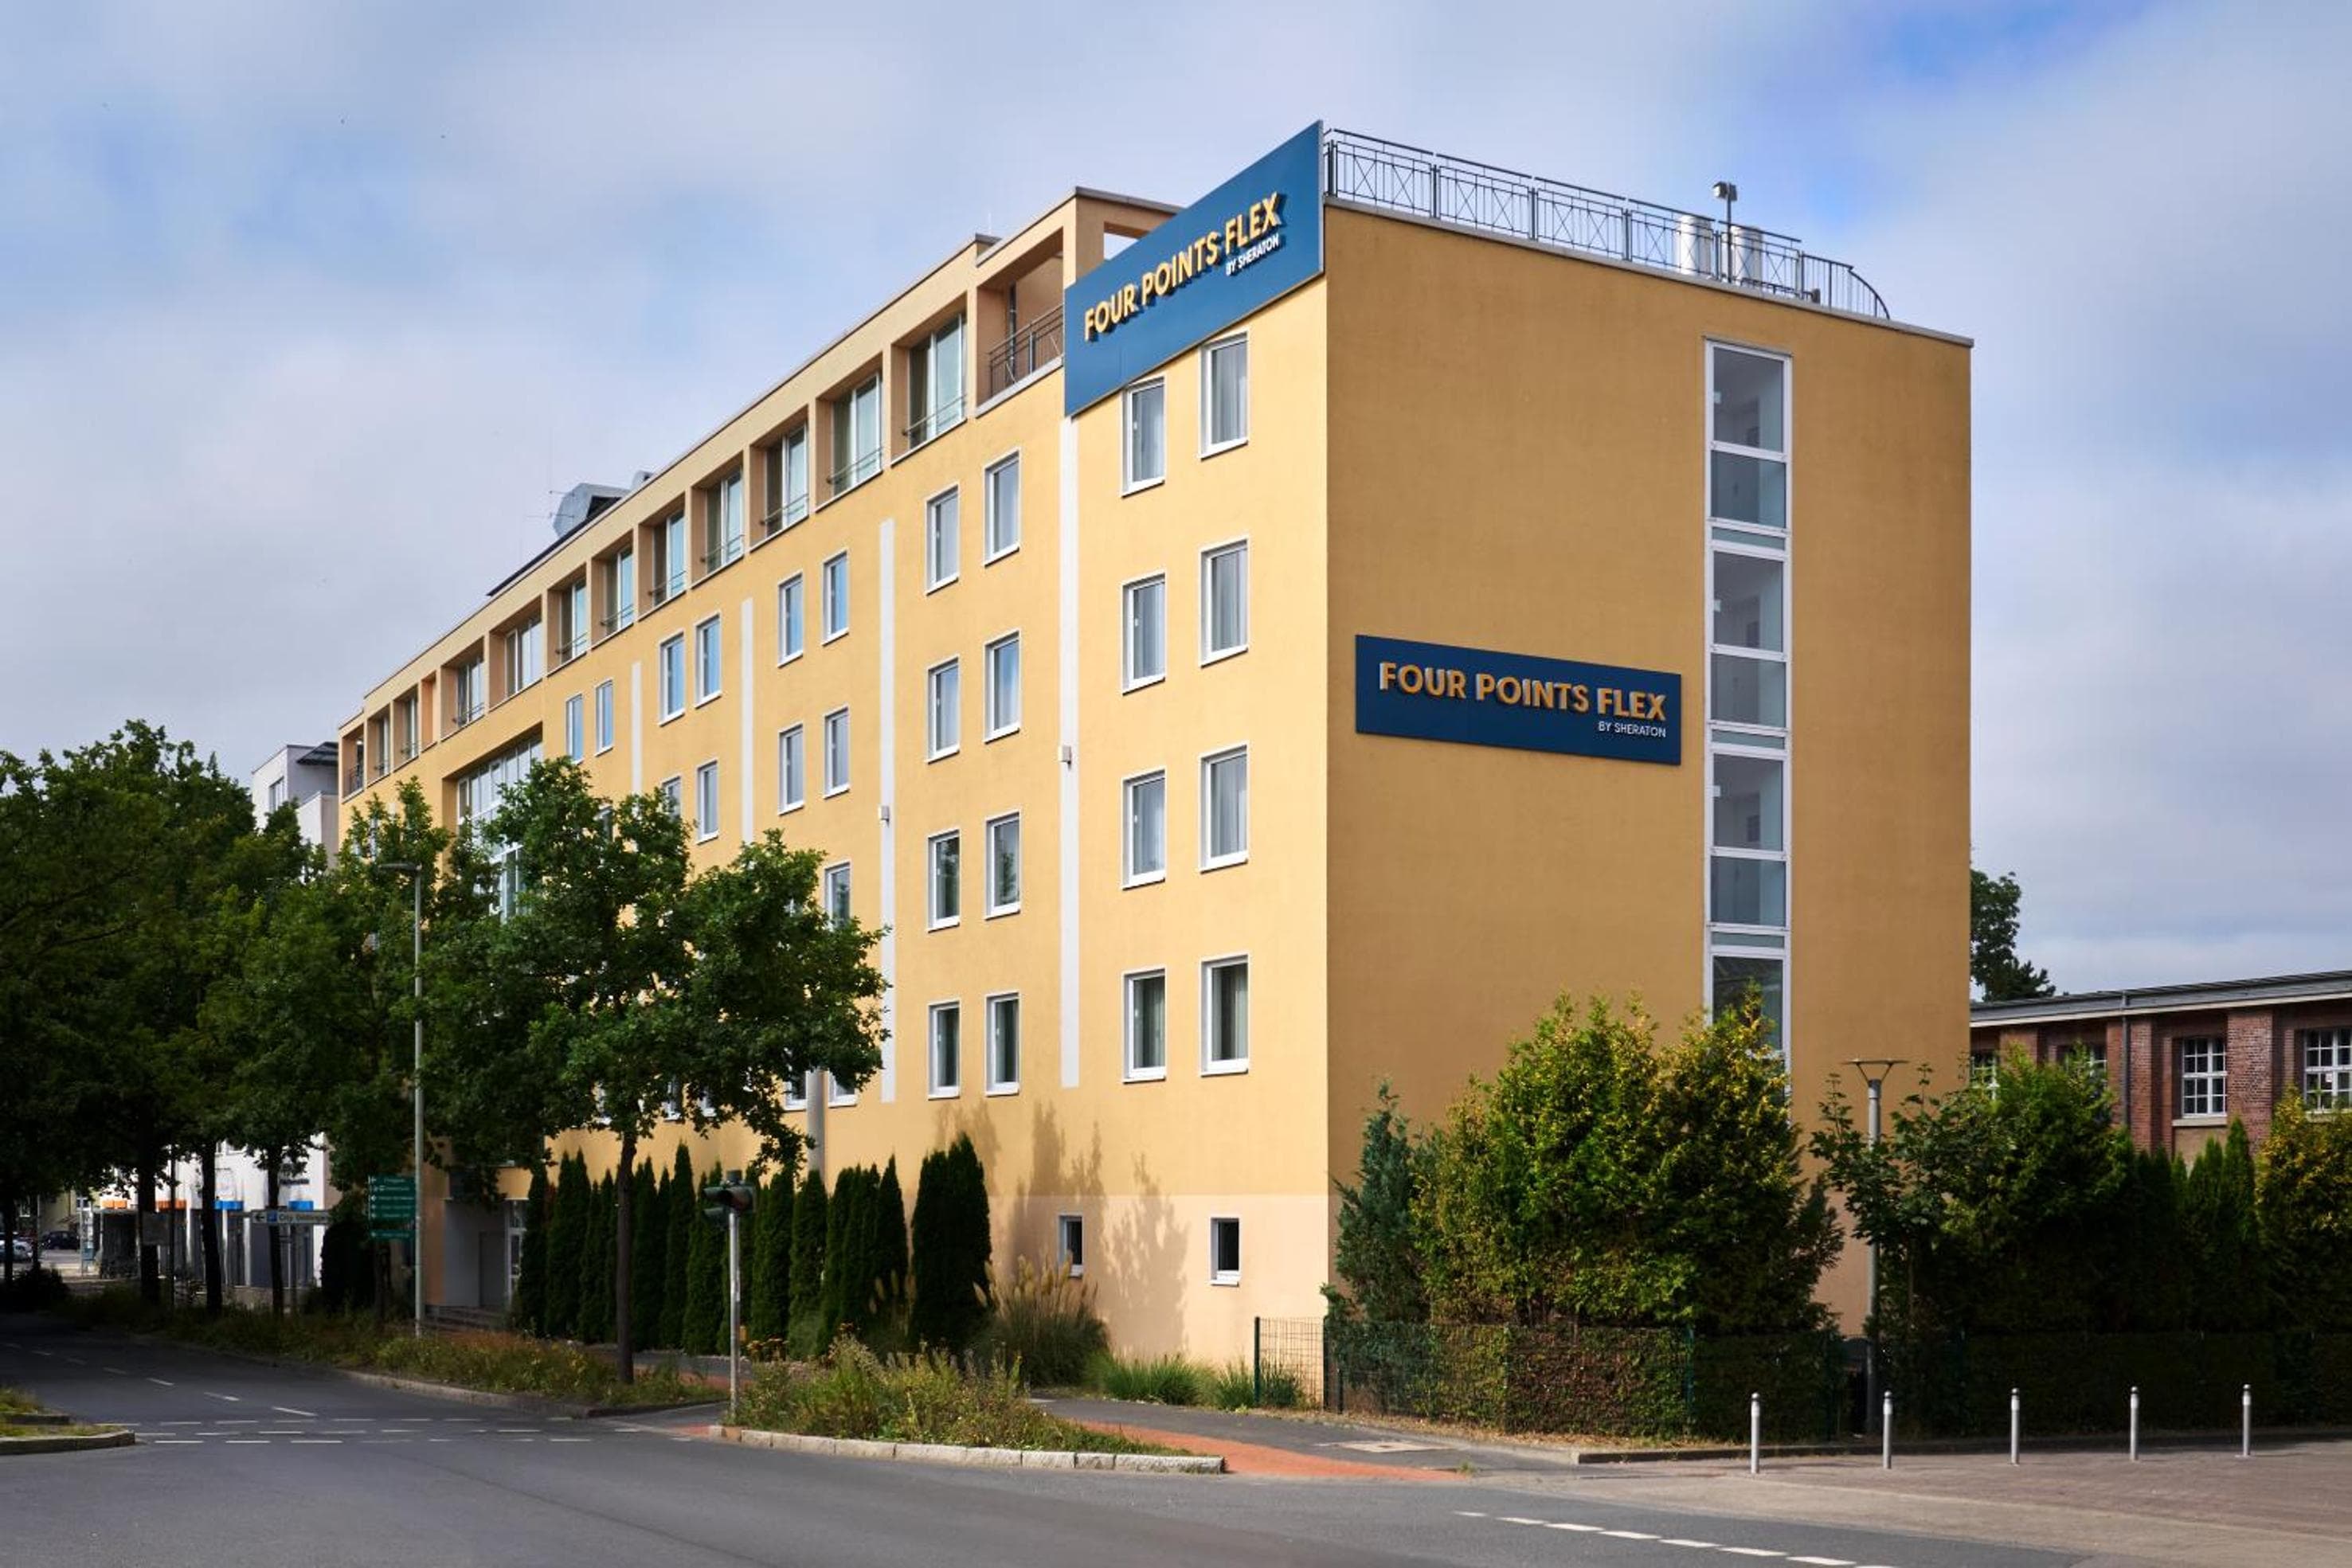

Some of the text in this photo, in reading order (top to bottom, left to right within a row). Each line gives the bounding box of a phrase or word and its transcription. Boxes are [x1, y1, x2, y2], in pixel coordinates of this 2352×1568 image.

[1084, 191, 1282, 342] FOUR POINTS FLEX
[1226, 233, 1279, 276] BY SHERATON
[1379, 662, 1666, 721] FOUR POINTS FLEX
[1598, 721, 1666, 738] BY SHERATON
